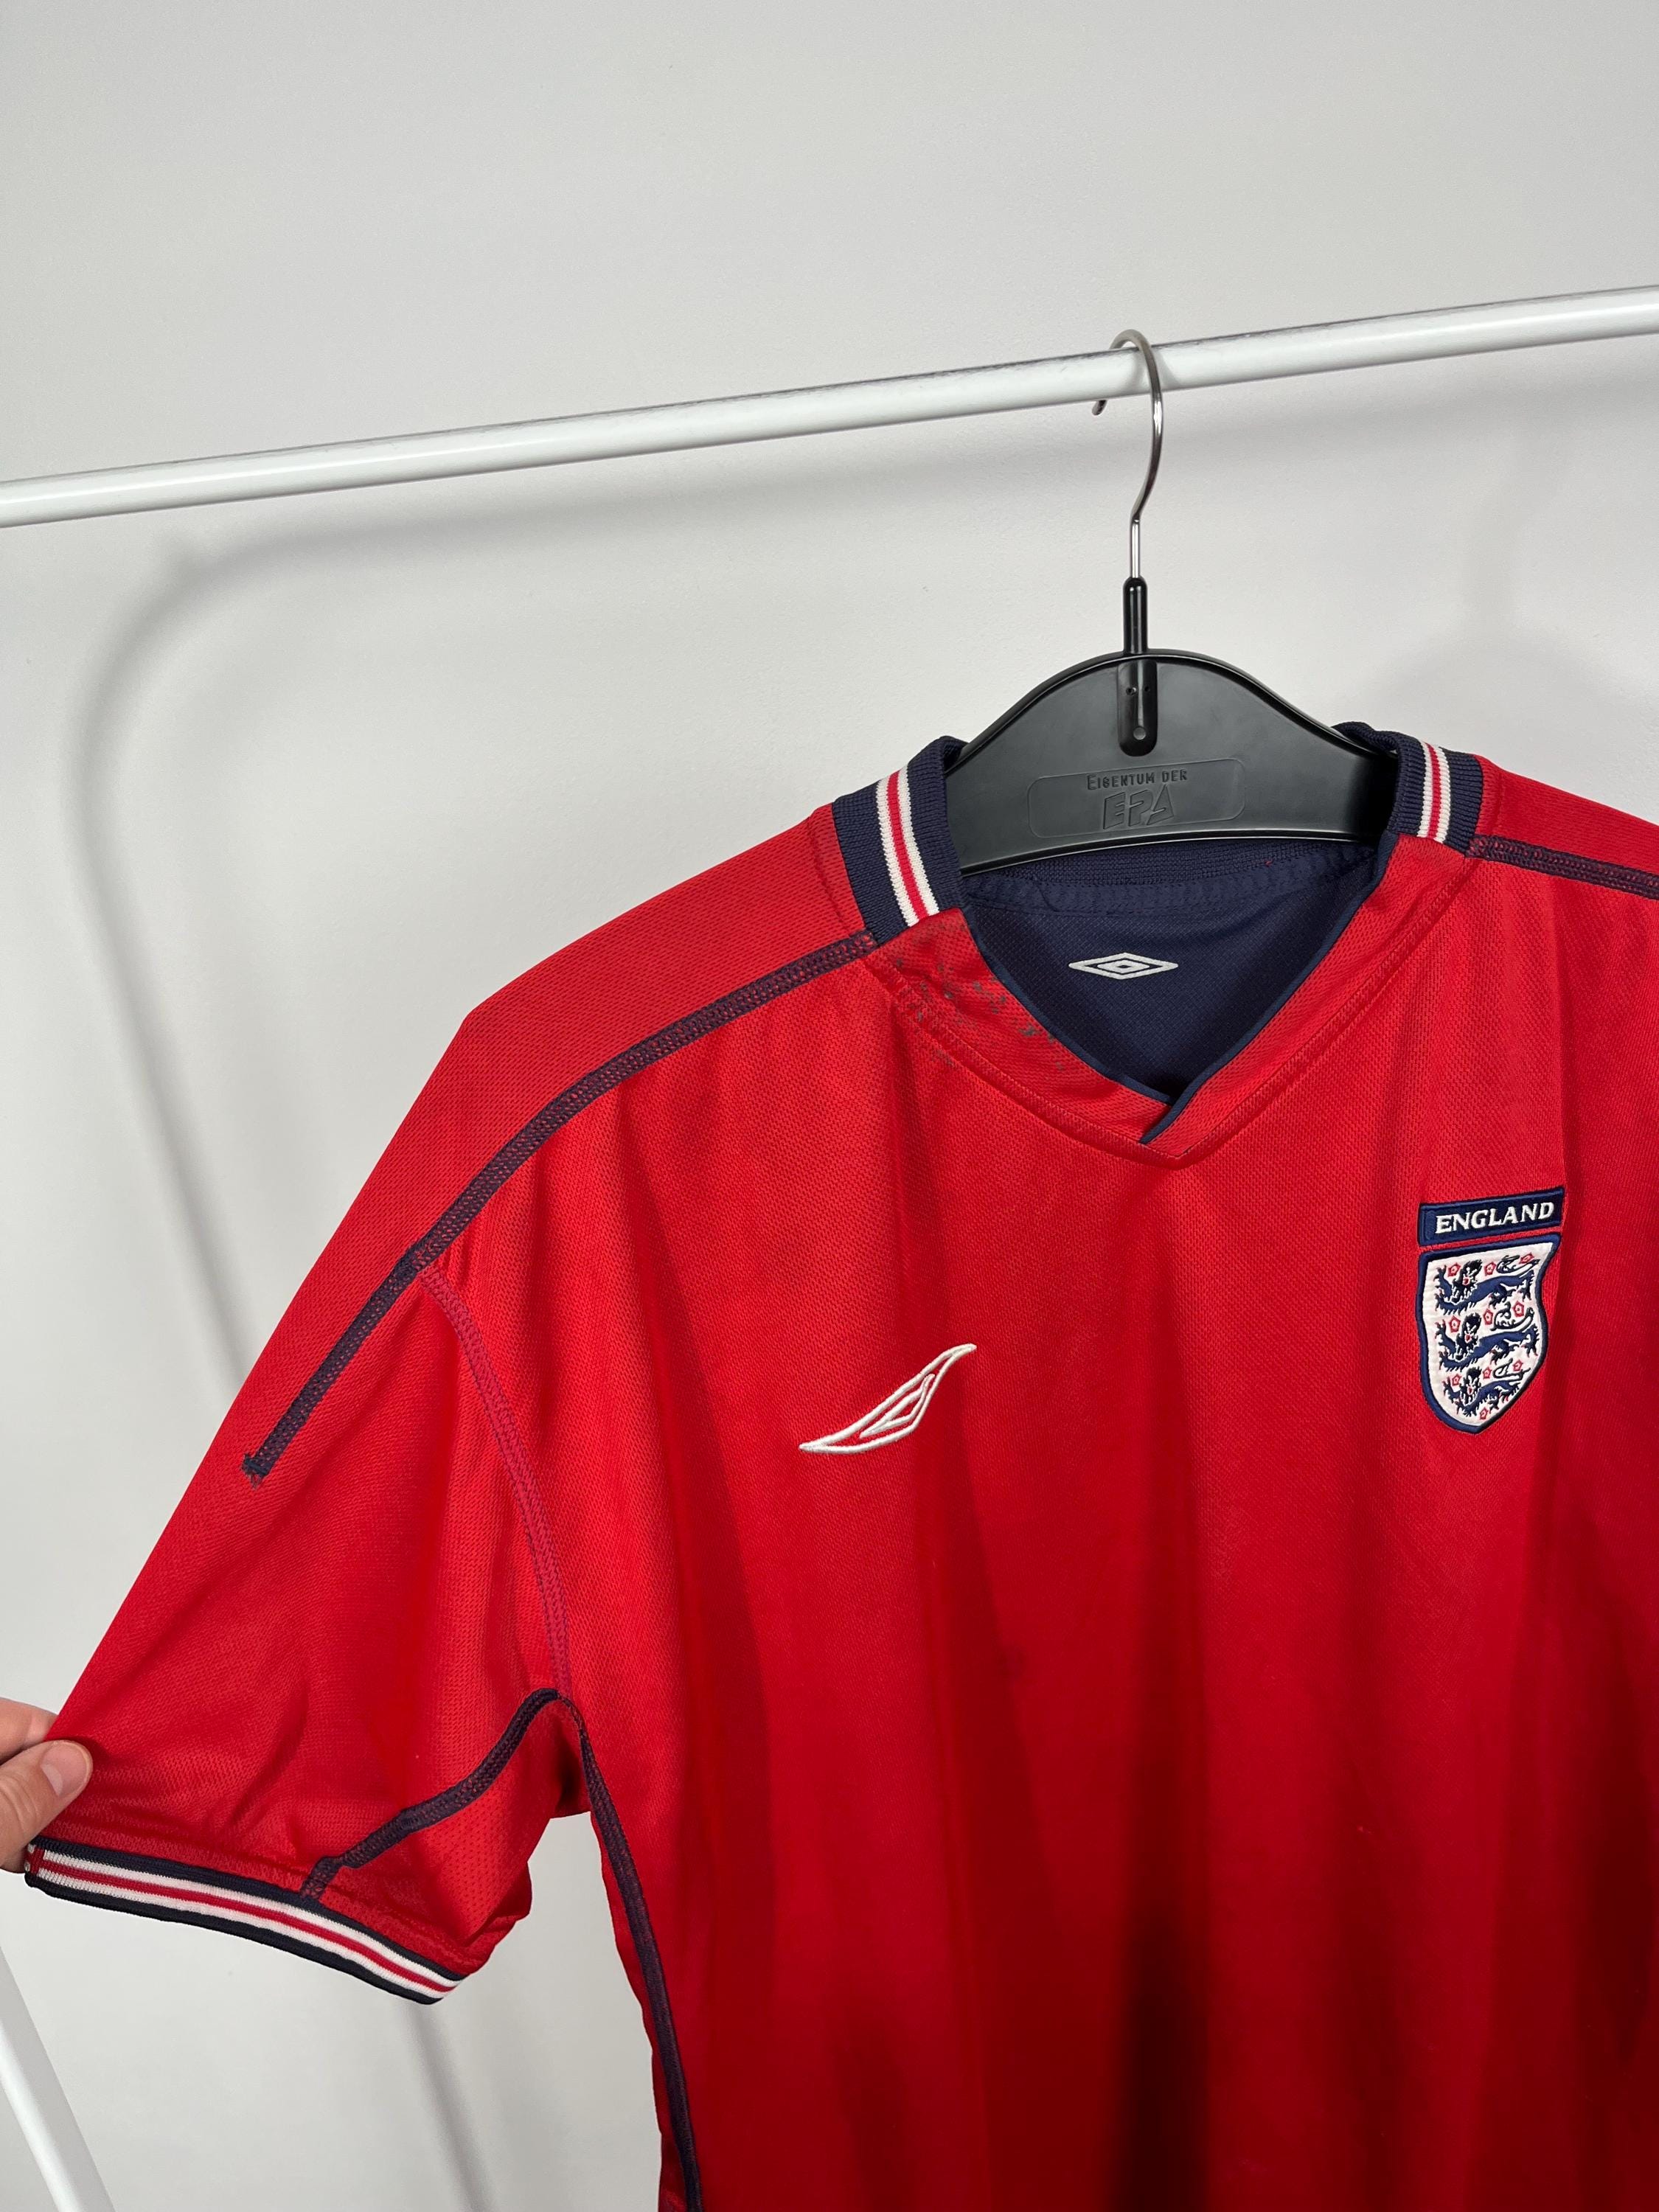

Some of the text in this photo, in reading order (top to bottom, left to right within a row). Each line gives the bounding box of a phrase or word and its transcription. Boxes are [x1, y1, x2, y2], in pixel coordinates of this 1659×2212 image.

[1087, 769, 1187, 790] EIGENTUM DER
[1102, 784, 1175, 830] EPA
[1435, 1201, 1554, 1234] ENGLAND
